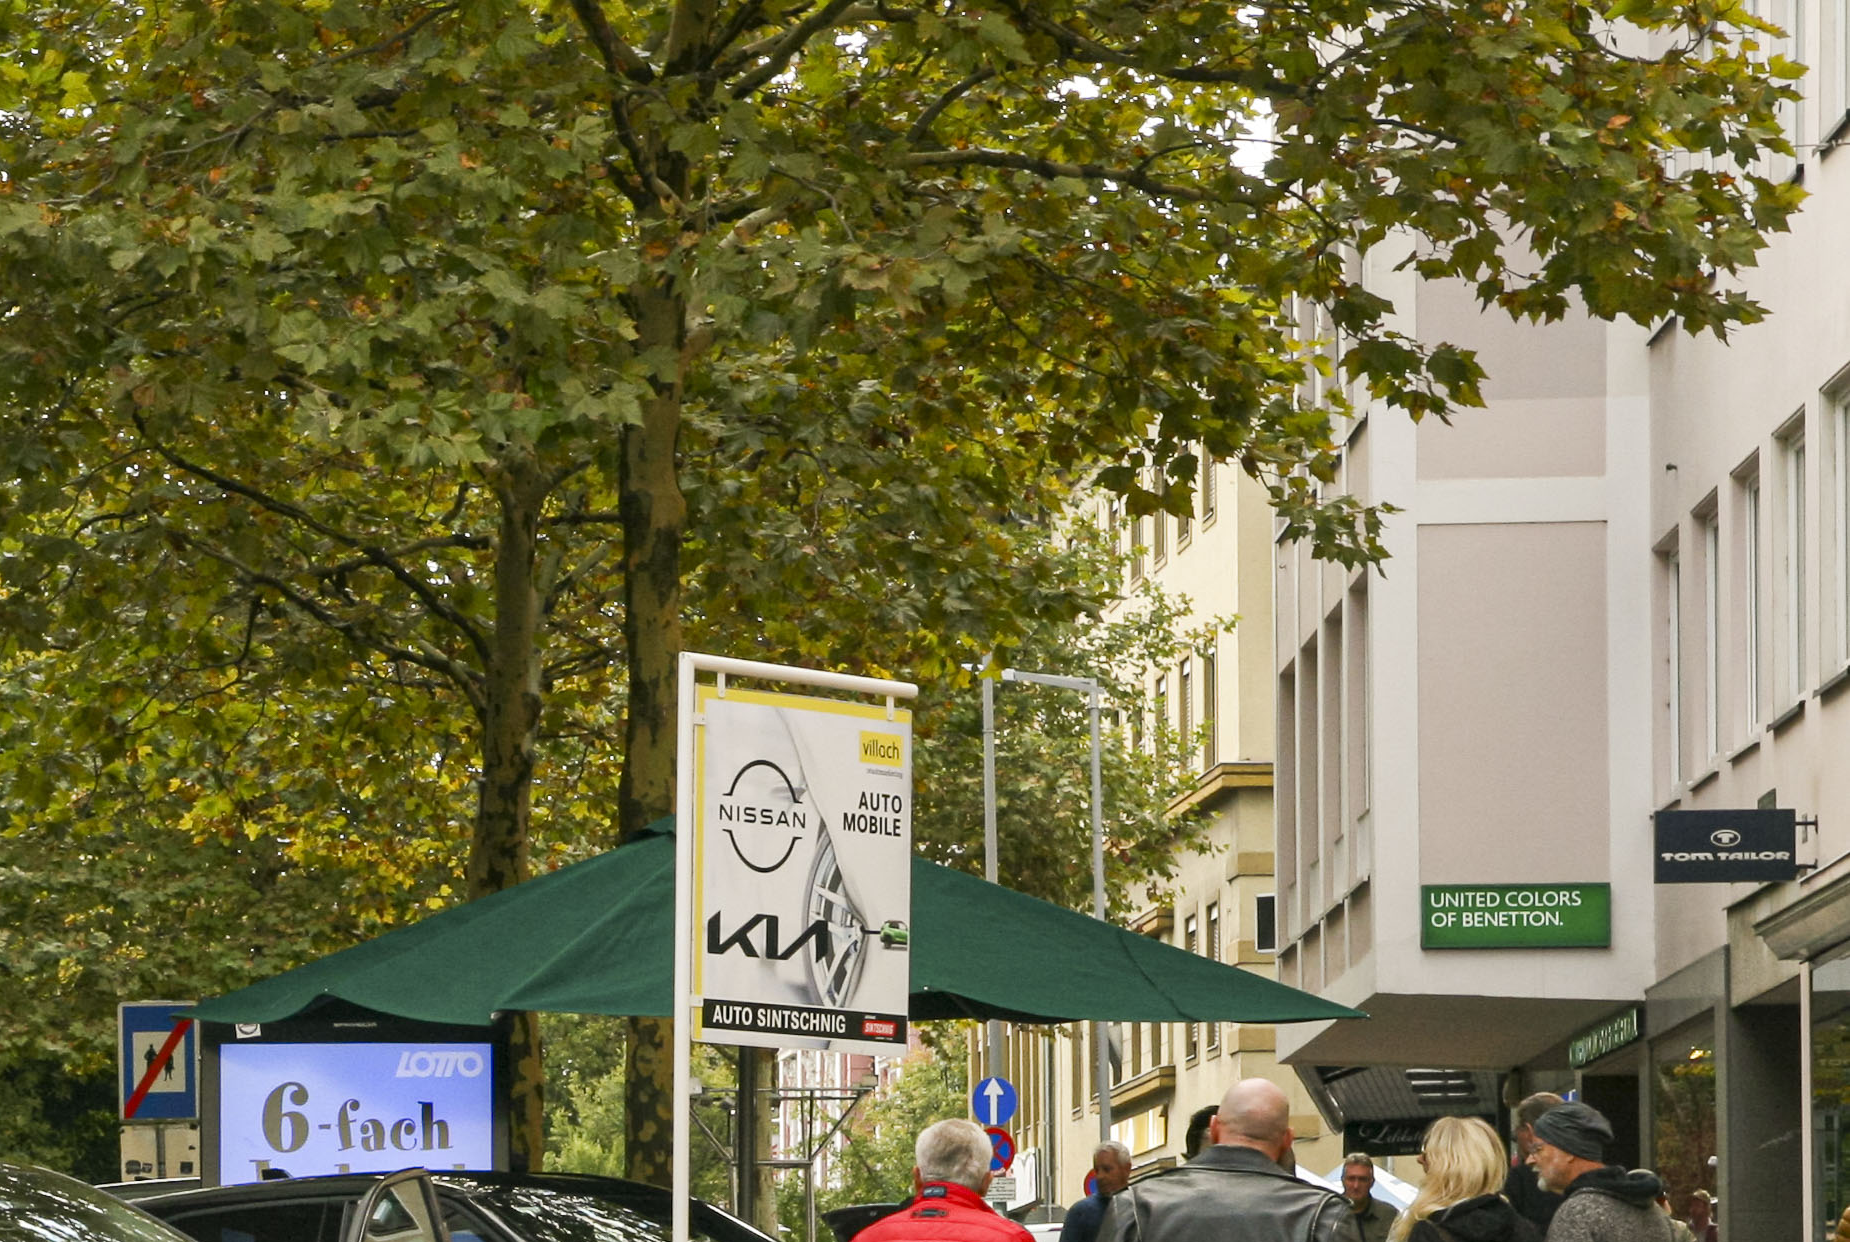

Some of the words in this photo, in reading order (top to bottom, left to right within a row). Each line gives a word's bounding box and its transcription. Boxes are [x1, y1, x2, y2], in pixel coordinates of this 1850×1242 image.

[863, 739, 900, 760] villach
[858, 791, 902, 814] AUTO
[720, 803, 806, 830] NISSAN
[843, 812, 901, 837] MOBILE
[1661, 852, 1714, 862] TOM
[1717, 851, 1790, 861] TAILOR
[1431, 891, 1501, 908] UNITED
[1505, 890, 1582, 907] COLORS
[1431, 911, 1457, 928] OF
[1462, 911, 1564, 928] BENETTON.
[707, 909, 829, 963] KIA
[713, 1005, 753, 1026] AUTO
[756, 1009, 847, 1034] SINTSCHNIG
[394, 1051, 484, 1079] LOTTO
